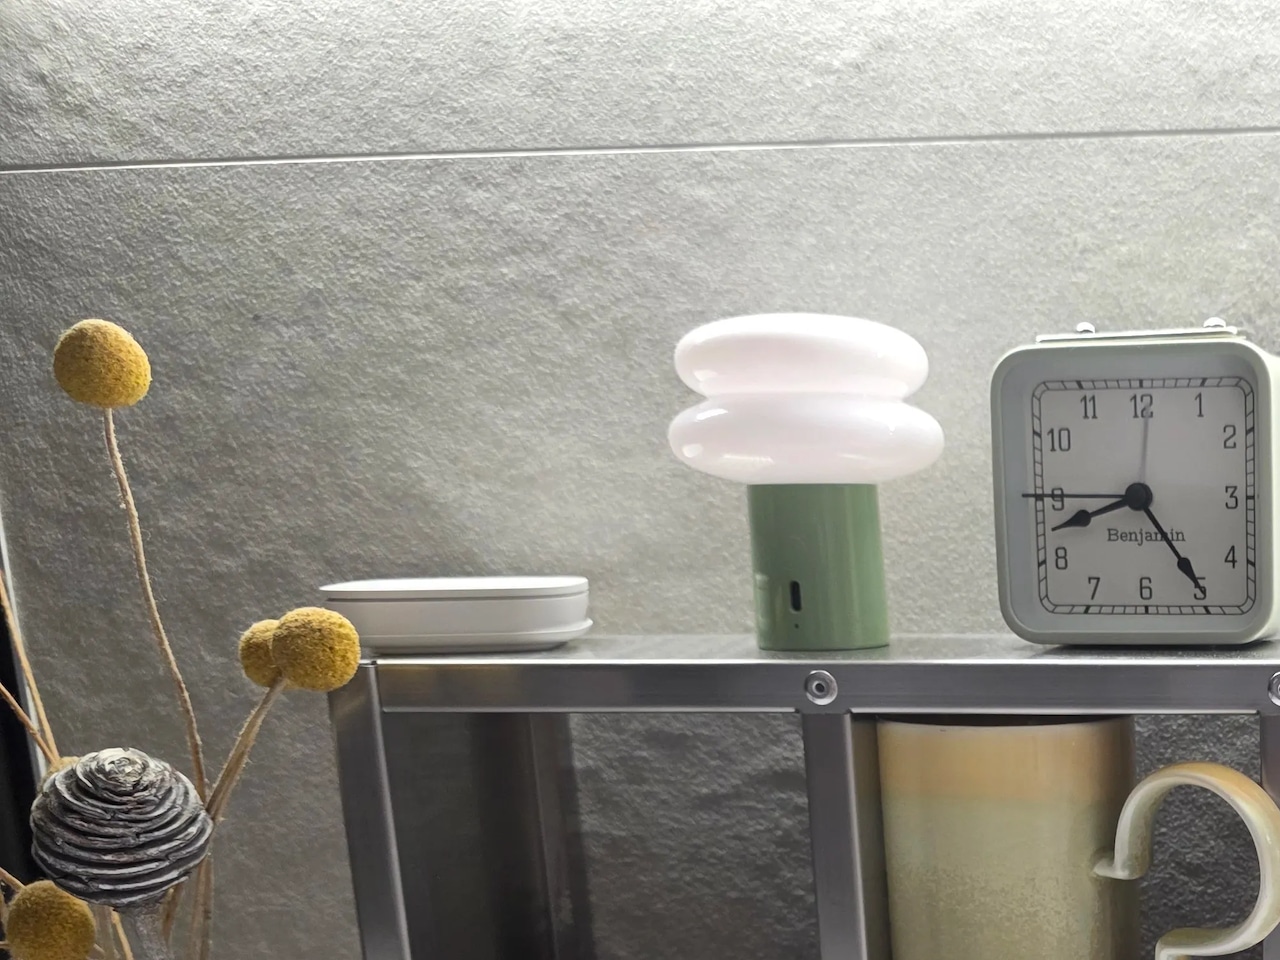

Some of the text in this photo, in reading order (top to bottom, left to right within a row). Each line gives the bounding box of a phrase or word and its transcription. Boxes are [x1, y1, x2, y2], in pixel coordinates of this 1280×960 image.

[1080, 395, 1098, 419] 11
[1129, 394, 1154, 419] 12
[1194, 392, 1205, 417] 1
[1047, 427, 1071, 452] 10
[1223, 424, 1237, 449] 2
[1051, 487, 1065, 511] 9
[1225, 485, 1239, 510] 3
[1106, 528, 1186, 546] Benjamin
[1055, 547, 1068, 570] 8
[1224, 545, 1238, 569] 4
[1088, 576, 1101, 600] 7
[1139, 577, 1153, 600] 6
[1193, 577, 1207, 601] 5
